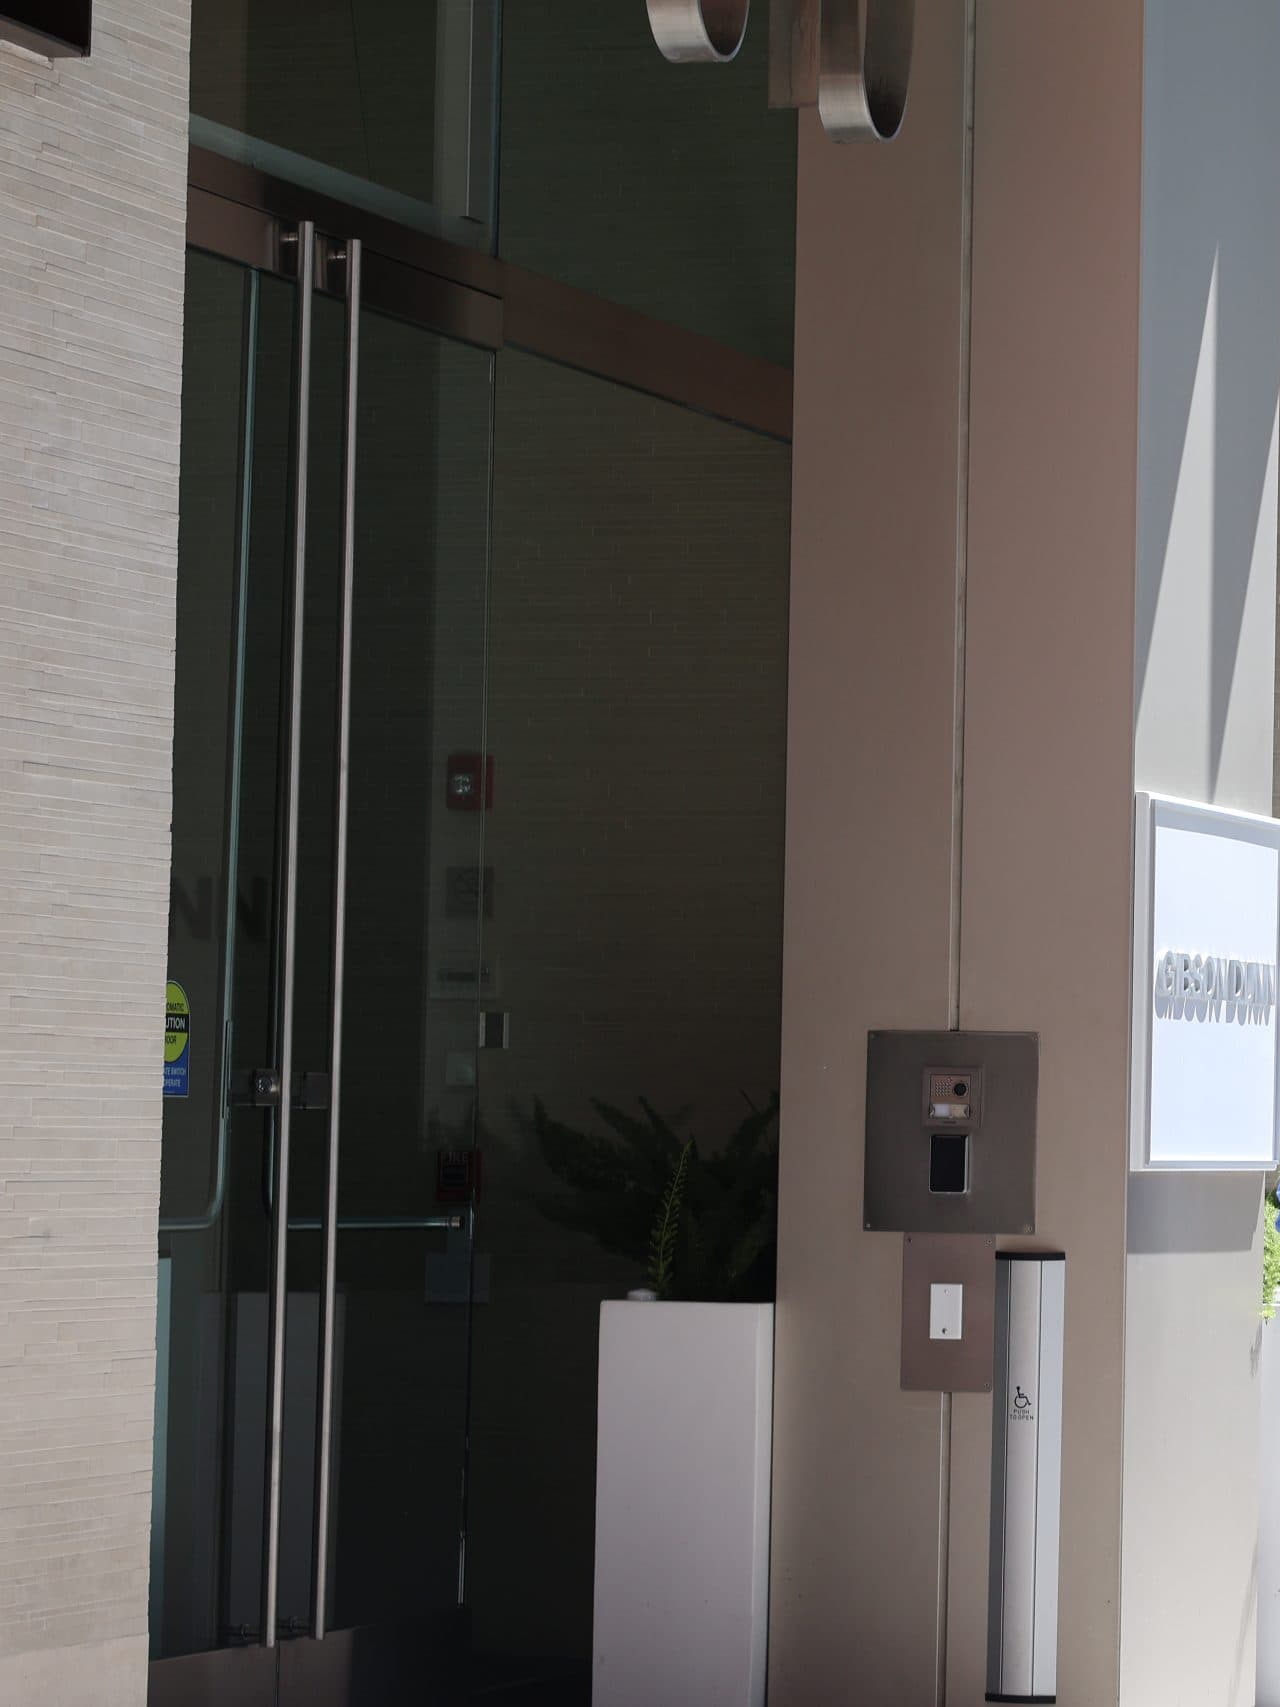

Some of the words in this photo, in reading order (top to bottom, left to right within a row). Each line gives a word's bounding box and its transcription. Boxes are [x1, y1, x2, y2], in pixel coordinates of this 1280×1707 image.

[1156, 950, 1227, 1001] GIBSON
[1228, 959, 1275, 1005] DUNN
[166, 1017, 185, 1029] UTION
